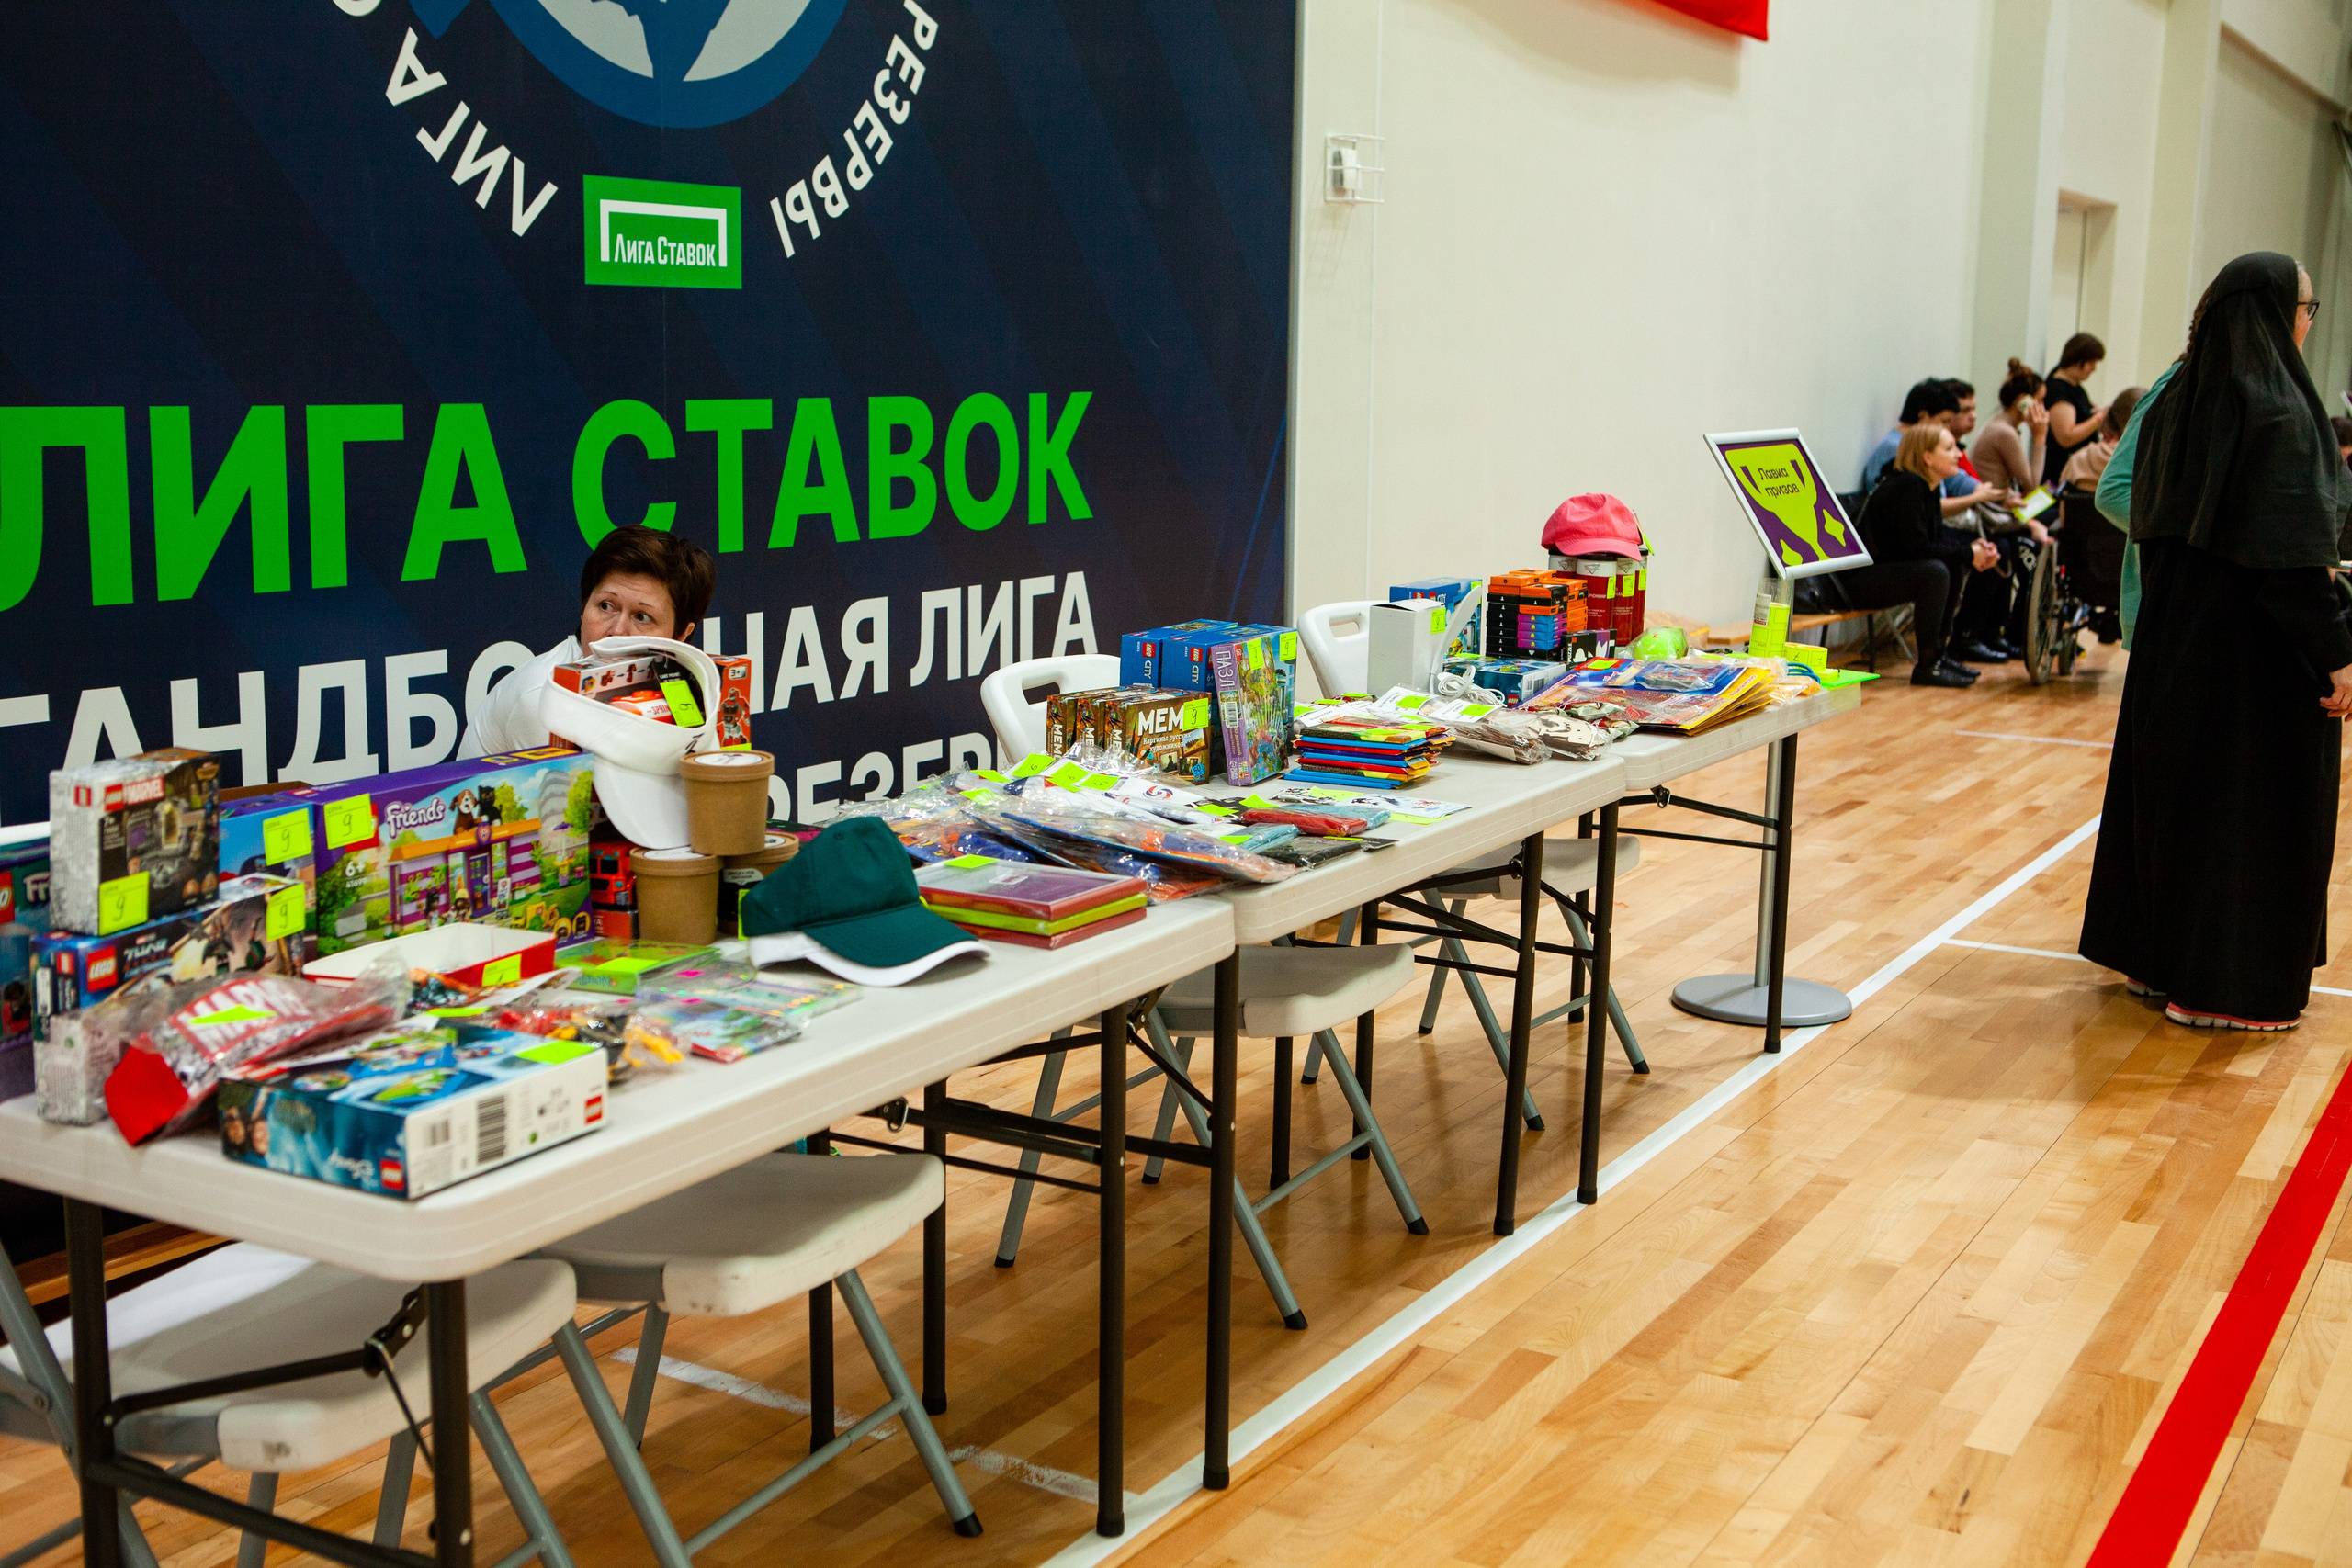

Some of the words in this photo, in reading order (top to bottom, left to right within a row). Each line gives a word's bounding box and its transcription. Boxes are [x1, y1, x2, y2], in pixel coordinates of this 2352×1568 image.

[386, 26, 559, 237] ЛИГА
[770, 0, 939, 258] РЕЗЕРВЫ
[1758, 468, 1788, 480] Лавка
[0, 403, 528, 612] ЛИГА
[572, 391, 1094, 553] СТАВОК
[1765, 483, 1800, 498] призов
[910, 571, 1099, 687] ЛИГА
[1216, 650, 1236, 687] ПАЗЛ
[1137, 705, 1184, 736] МЕМ
[1191, 708, 1198, 725] 9
[341, 813, 353, 838] 9
[386, 797, 445, 838] Friends
[280, 829, 291, 853] 9
[345, 861, 366, 876] 6+
[114, 895, 126, 922] 9
[278, 904, 288, 930] 9
[89, 958, 116, 979] LEGO
